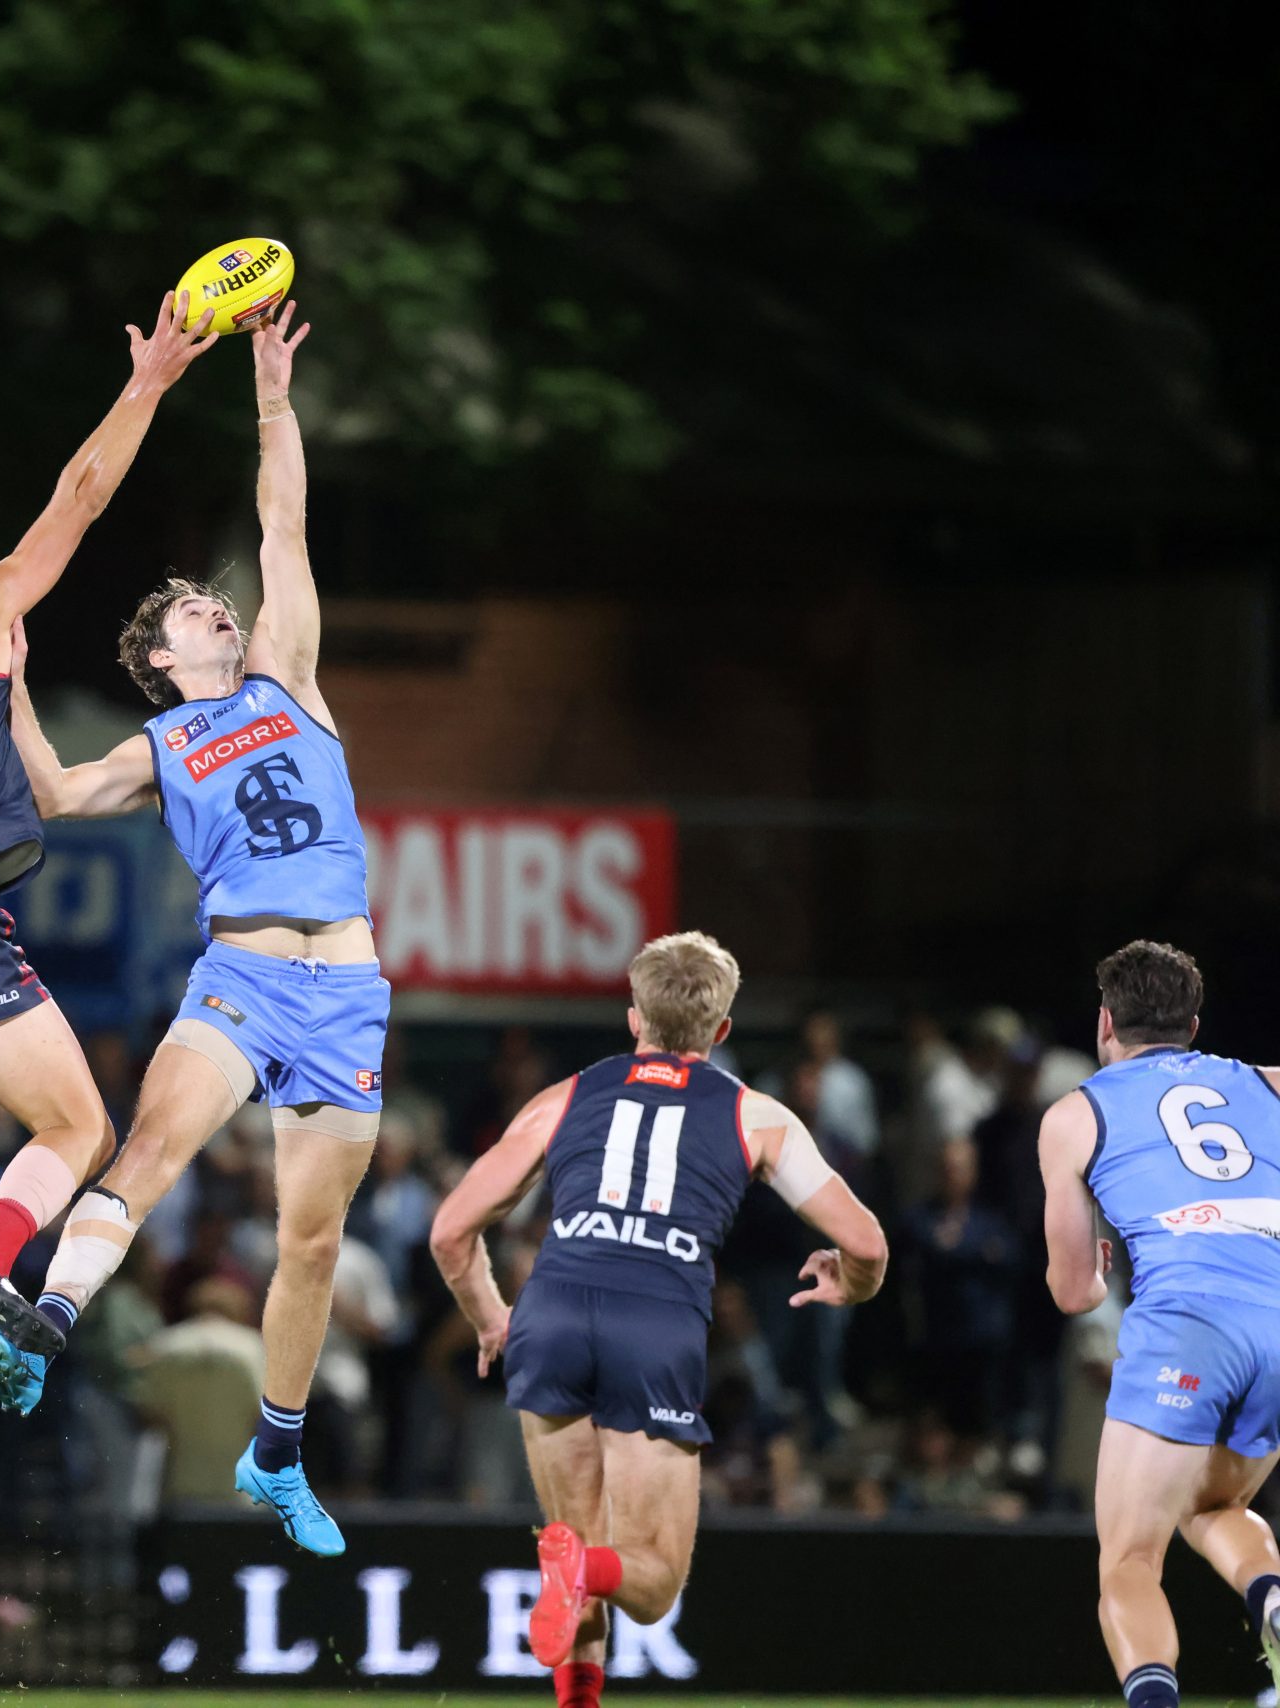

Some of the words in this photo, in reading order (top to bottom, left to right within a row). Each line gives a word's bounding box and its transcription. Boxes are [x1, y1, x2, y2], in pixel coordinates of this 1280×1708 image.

[202, 245, 281, 300] SHERRIN
[363, 817, 647, 984] AIRS
[597, 1099, 686, 1216] 11
[1157, 1084, 1255, 1182] 6
[553, 1210, 700, 1262] VAILO
